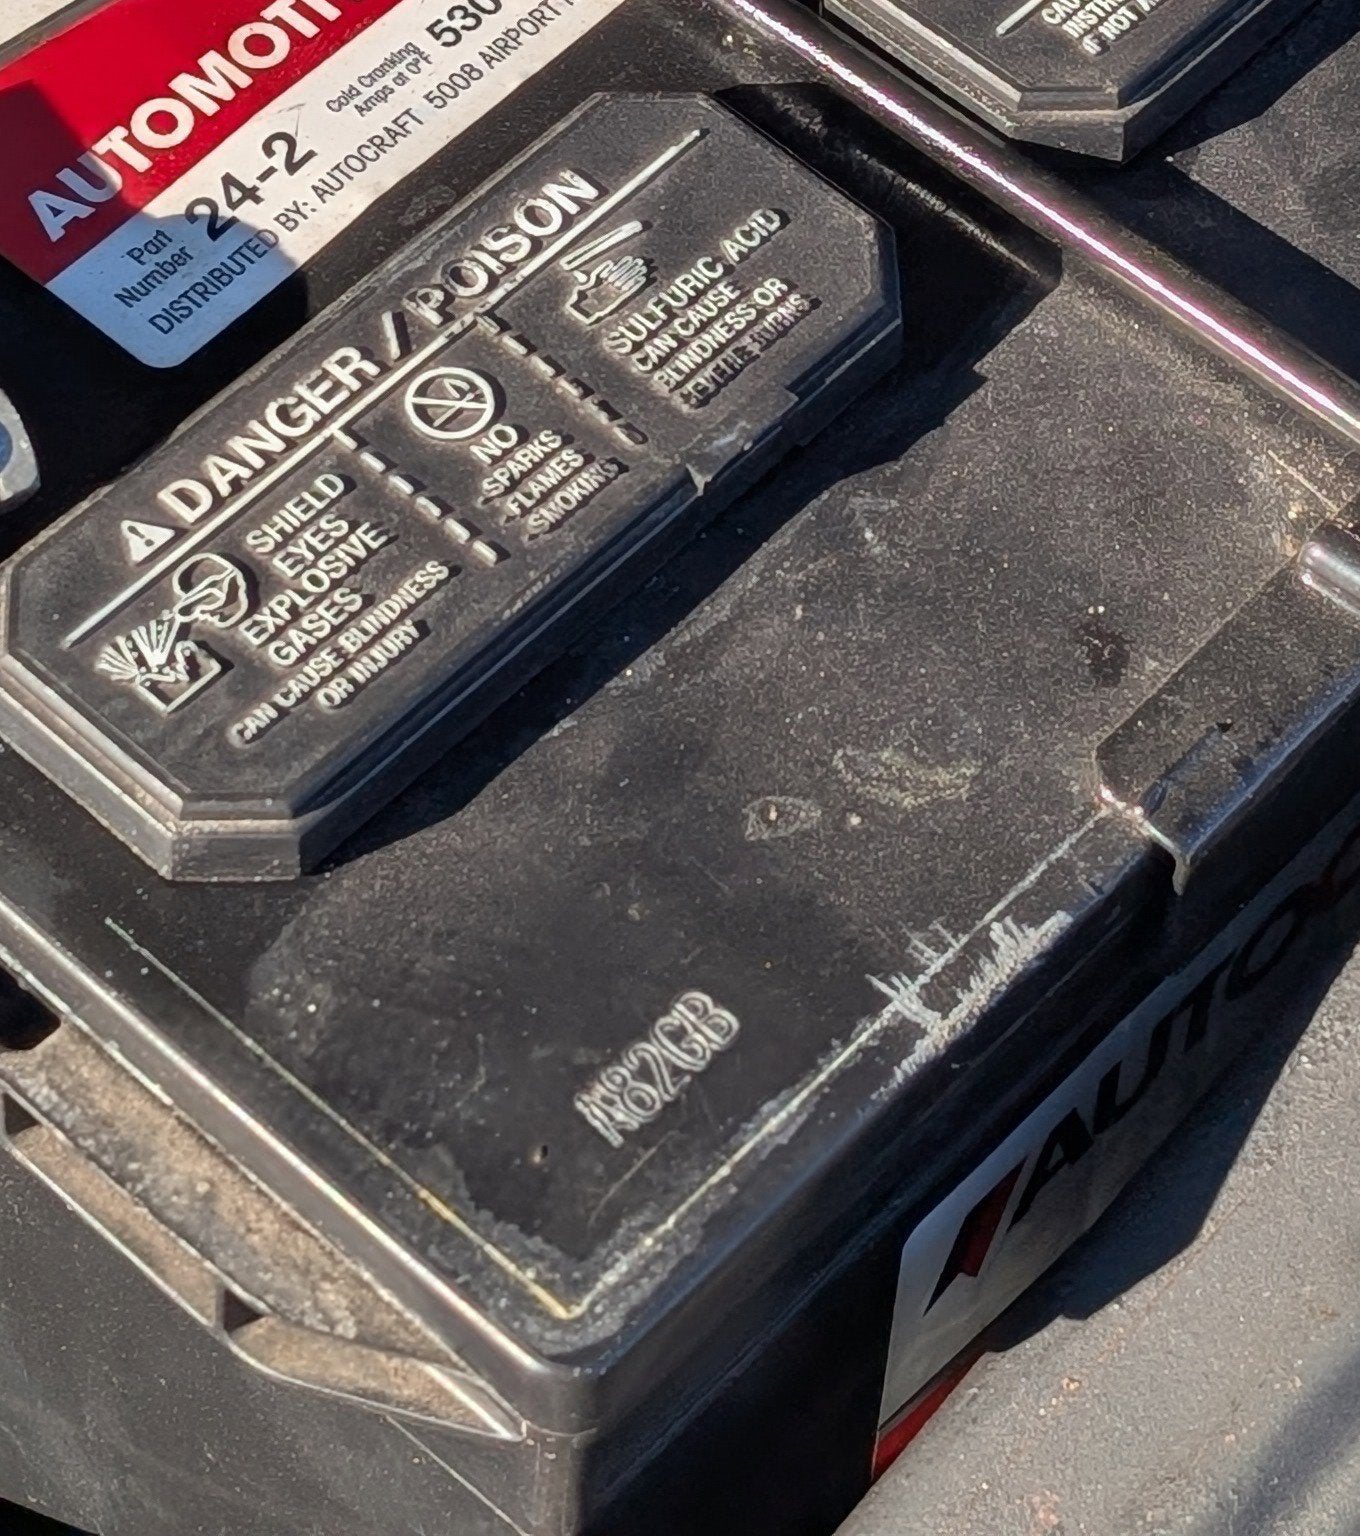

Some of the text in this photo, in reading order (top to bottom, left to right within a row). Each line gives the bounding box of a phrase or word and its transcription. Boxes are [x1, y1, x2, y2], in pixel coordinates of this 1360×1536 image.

[1080, 34, 1103, 55] IF
[1098, 6, 1137, 39] NOT
[326, 42, 423, 112] Cold Cranking
[354, 85, 394, 117] Amps
[392, 70, 410, 86] at
[114, 131, 318, 309] Part Number 24-2
[148, 228, 280, 335] DISTRIBUTED
[272, 200, 317, 232] BY:
[311, 107, 424, 204] AUTOCRAFT
[423, 64, 483, 108] 5008
[603, 209, 780, 353] SULFURIC ACID
[157, 347, 380, 523] DANGER
[404, 170, 598, 325] POISON
[630, 281, 740, 371] CAN CAUSE
[653, 277, 787, 392] BLINDNESS OR
[470, 424, 517, 464] NO
[482, 430, 561, 497] SPARKS
[506, 449, 583, 514] FLAMES
[246, 474, 344, 553] SHIELD
[521, 463, 617, 533] SMOKING
[238, 522, 387, 647] EXPLOSIVE
[272, 514, 348, 579] EYES
[230, 703, 277, 741] CAN
[272, 647, 343, 706] CAUSE
[338, 561, 448, 653] BLINDNESS
[267, 588, 362, 665] GASES
[316, 619, 418, 706] OR INJURY
